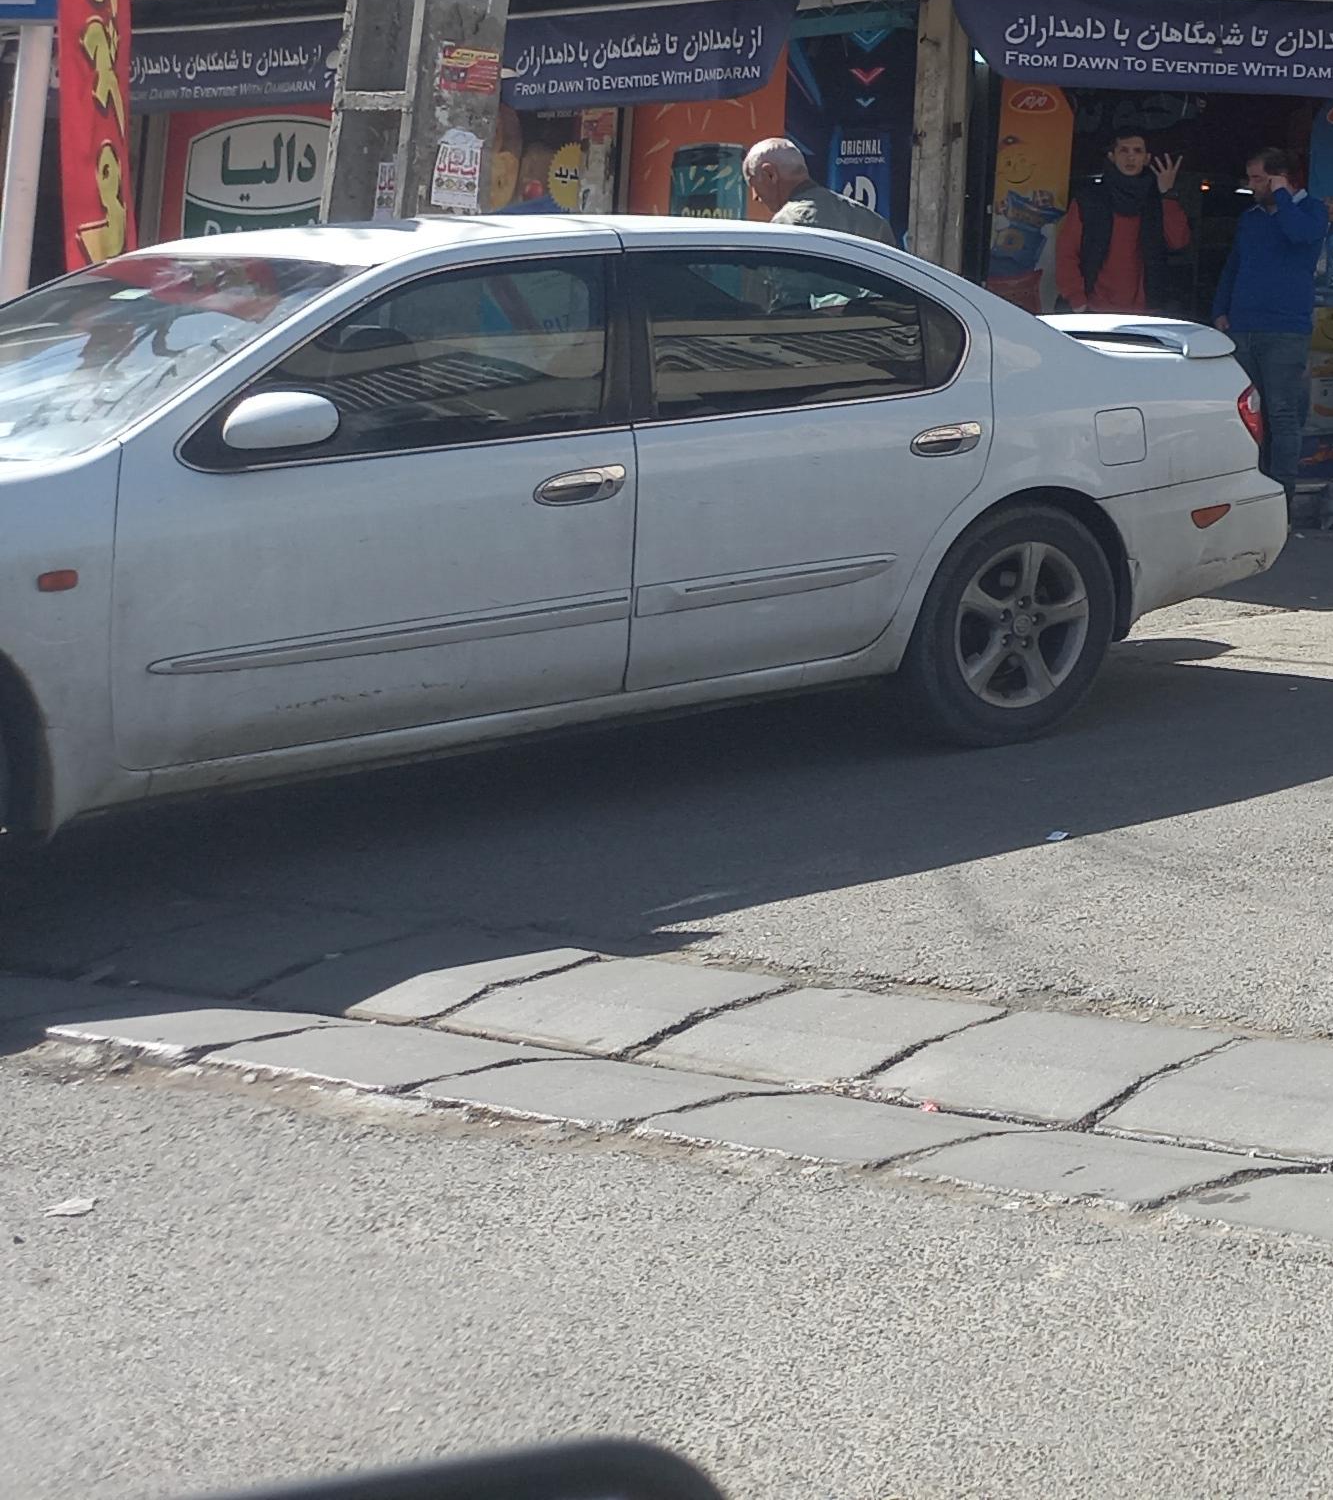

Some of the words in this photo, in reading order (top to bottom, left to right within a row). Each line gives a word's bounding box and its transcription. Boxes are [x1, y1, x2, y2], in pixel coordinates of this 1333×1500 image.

[665, 33, 678, 54] تا
[683, 27, 744, 62] بامدادان
[748, 25, 763, 59] از
[1004, 15, 1105, 48] دامداران
[1112, 19, 1130, 48] با
[1137, 21, 1244, 51] شامگاهان
[1250, 26, 1269, 47] تا
[515, 42, 577, 77] دامداران
[578, 41, 589, 68] با
[592, 32, 662, 69] شامگاهان
[1004, 50, 1058, 68] FROM
[1063, 53, 1120, 71] DAWN
[1123, 56, 1147, 73] TO
[1151, 58, 1238, 76] EVENTIDE
[1242, 62, 1287, 78] WITH
[514, 81, 545, 96] FROM
[548, 79, 584, 94] DAWN
[586, 76, 601, 91] TO
[602, 73, 659, 90] EVENTIDE
[661, 70, 692, 84] WITH
[694, 66, 761, 82] DAMDARAN
[840, 139, 882, 155] ORIGINAL
[221, 132, 317, 202] دالیا
